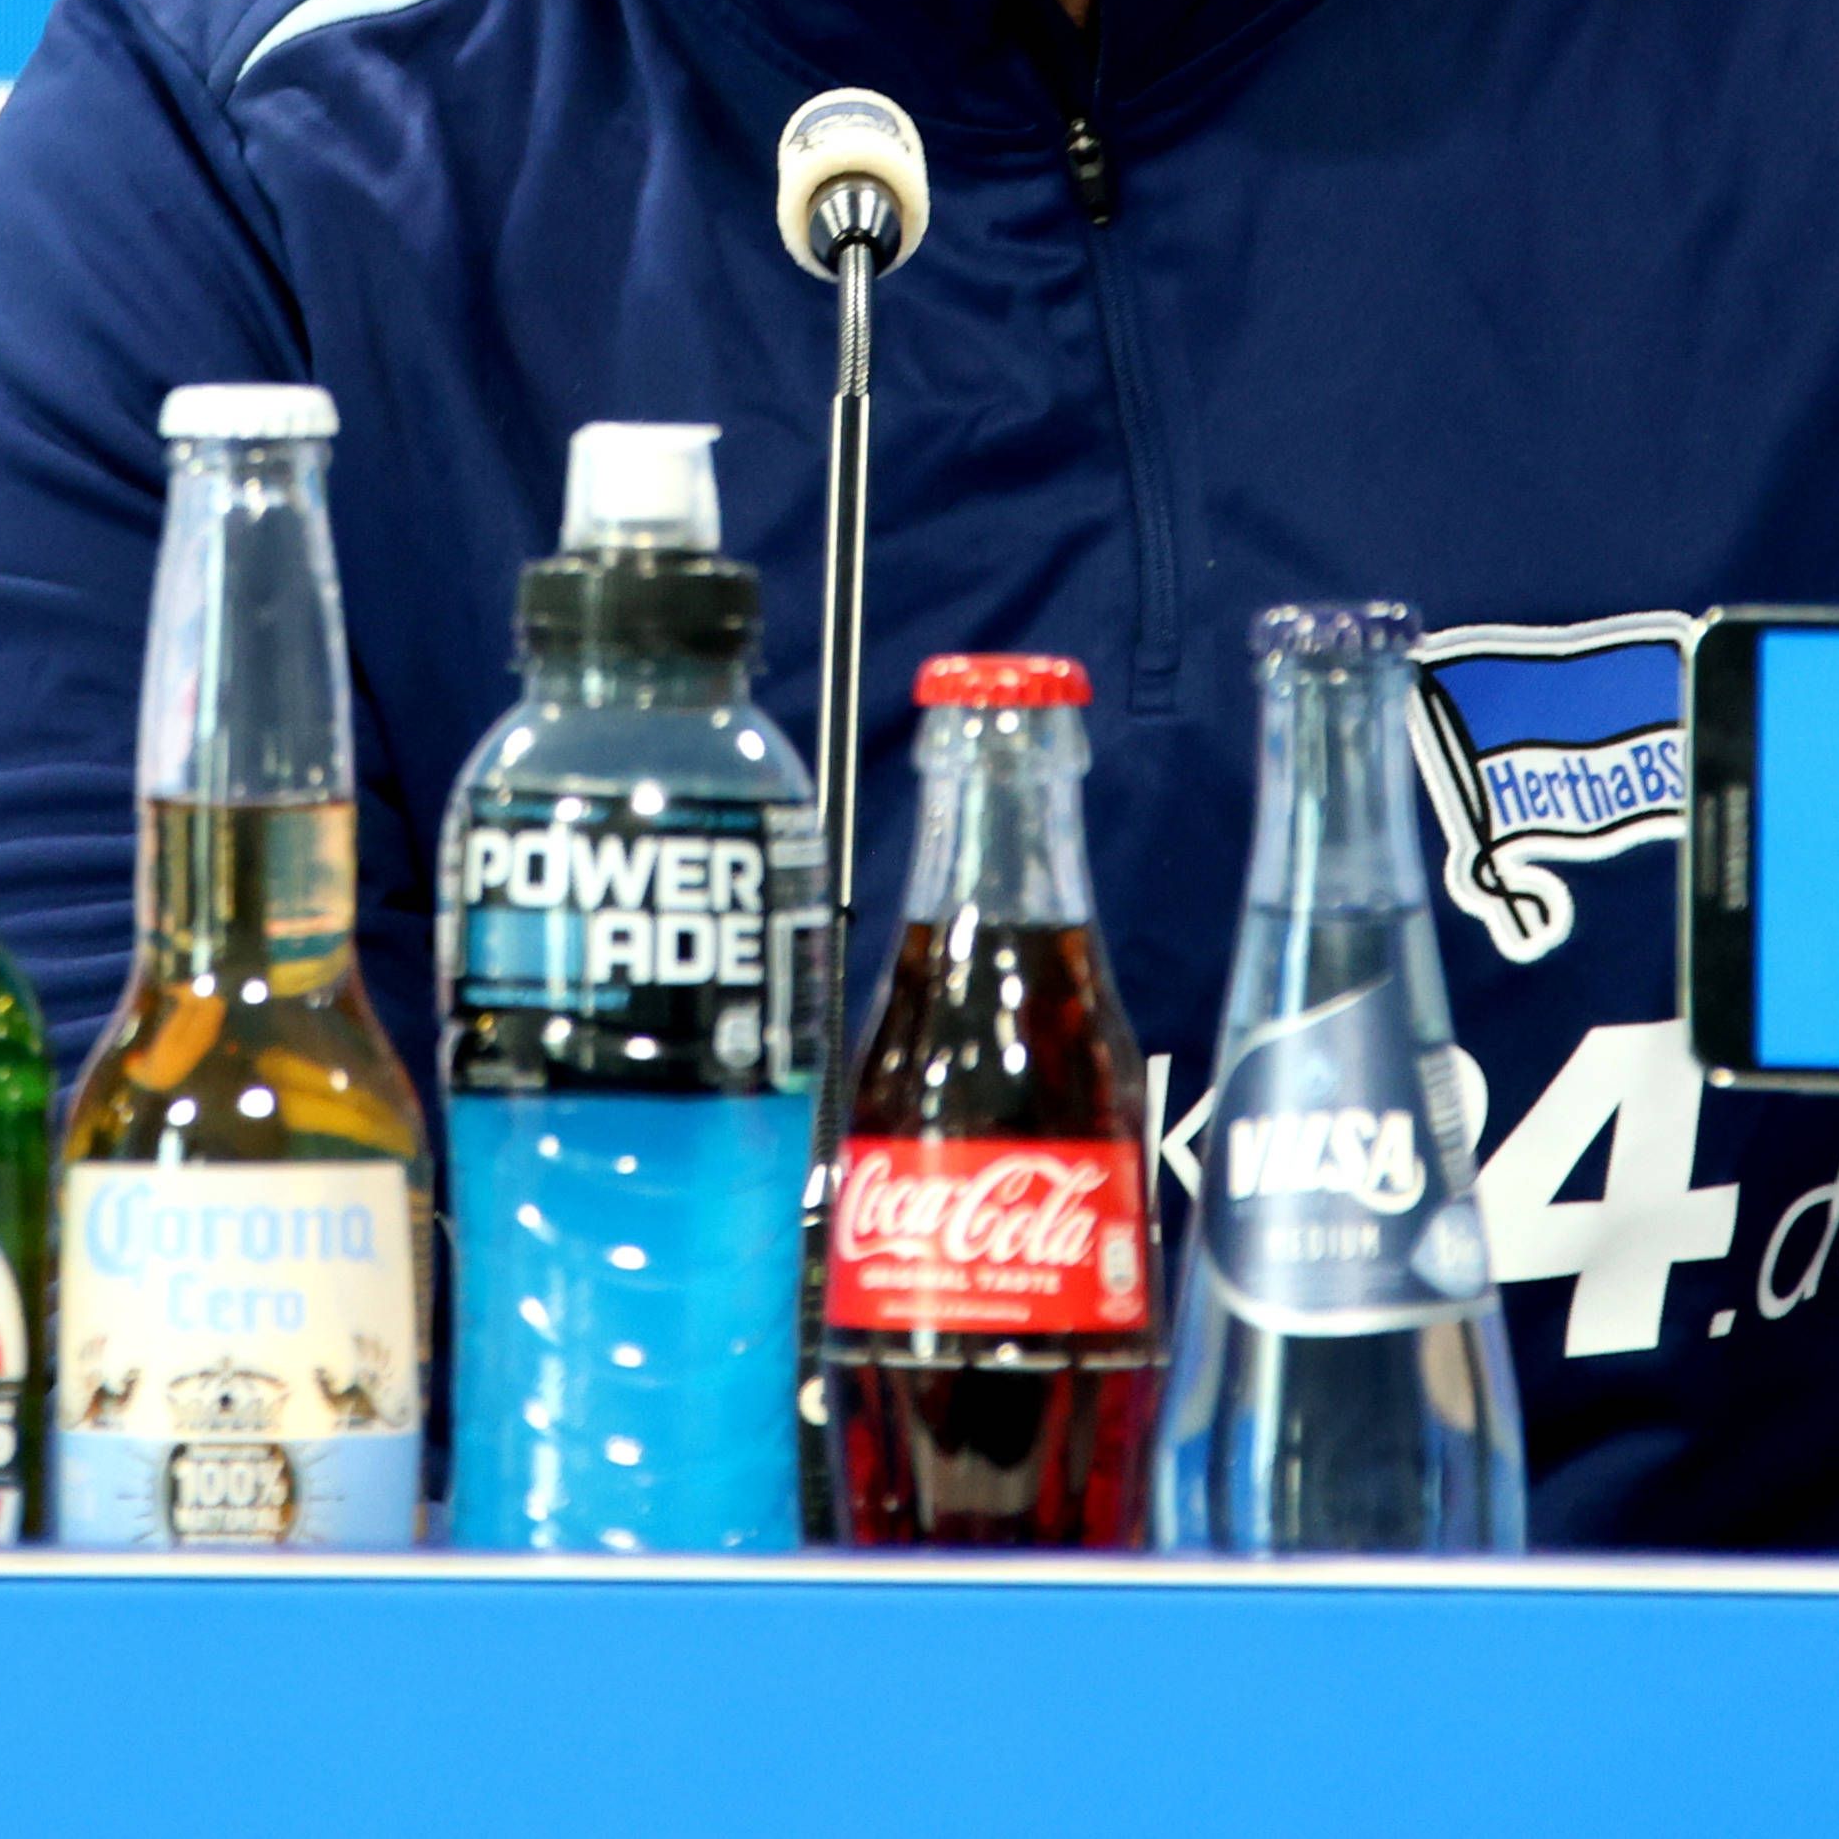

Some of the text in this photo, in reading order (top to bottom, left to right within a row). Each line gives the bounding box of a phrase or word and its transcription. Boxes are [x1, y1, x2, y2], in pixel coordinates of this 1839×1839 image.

[463, 825, 764, 915] POWER
[583, 907, 765, 987] ADE
[83, 1175, 379, 1289] Corona
[835, 1151, 1111, 1269] Coca-Cola
[163, 1265, 311, 1335] Cero
